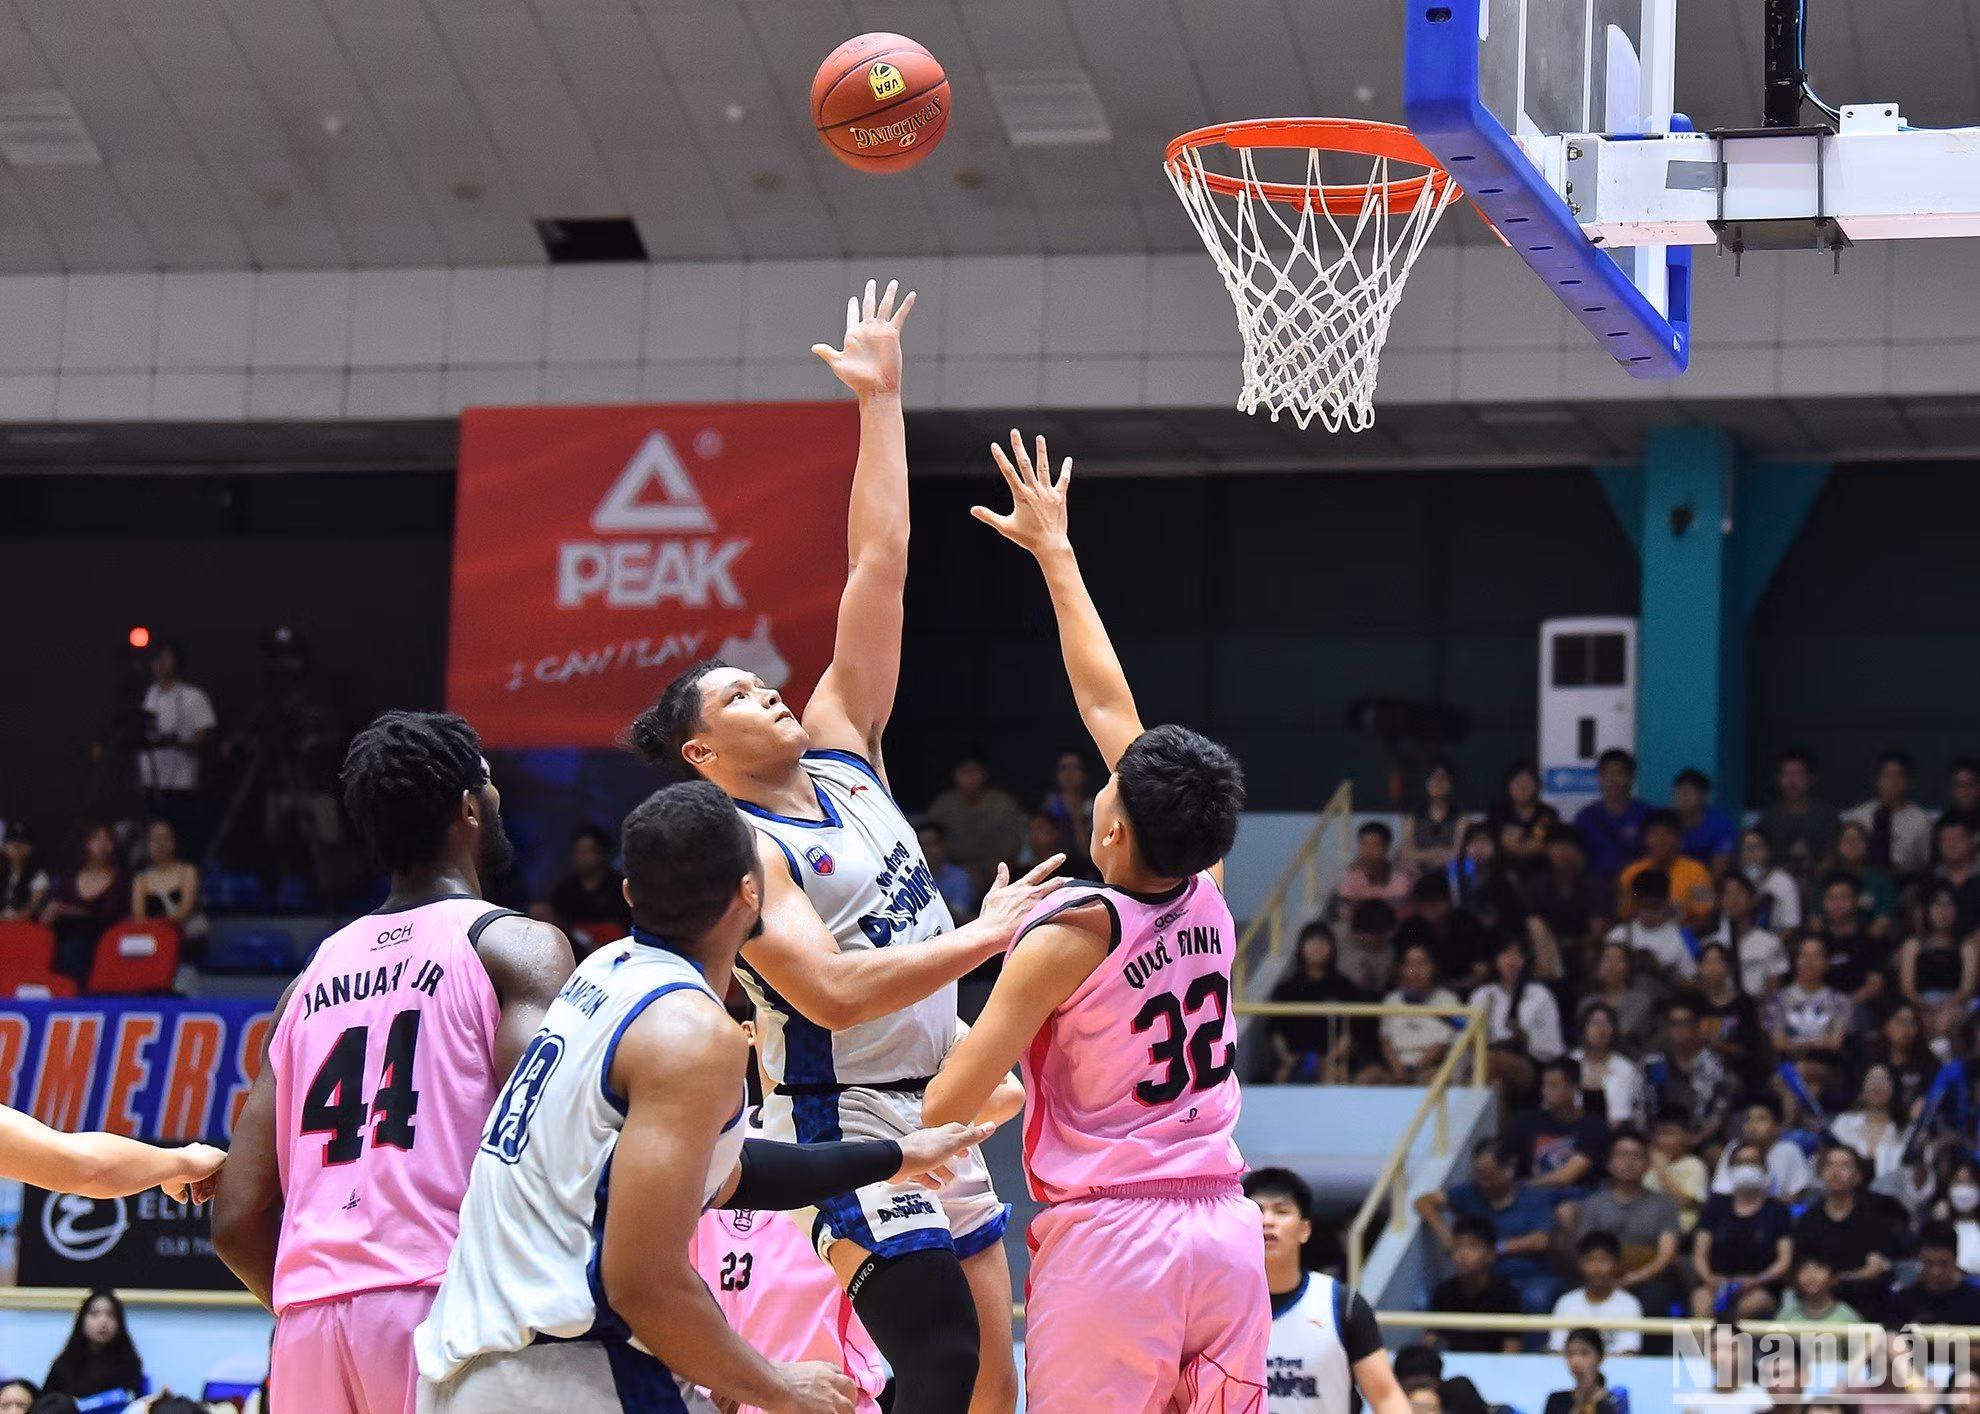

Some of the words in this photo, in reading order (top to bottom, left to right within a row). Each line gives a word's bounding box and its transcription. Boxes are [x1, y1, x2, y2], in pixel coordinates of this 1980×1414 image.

[875, 78, 899, 95] VBA
[854, 95, 941, 149] SPALDING
[556, 538, 752, 610] PEAK
[808, 847, 825, 864] VBA
[377, 922, 414, 945] OCH
[411, 959, 445, 998] JR
[1130, 970, 1237, 1108] 32
[300, 1008, 420, 1169] 44
[720, 1251, 753, 1292] 23
[852, 1262, 875, 1295] SALVEO
